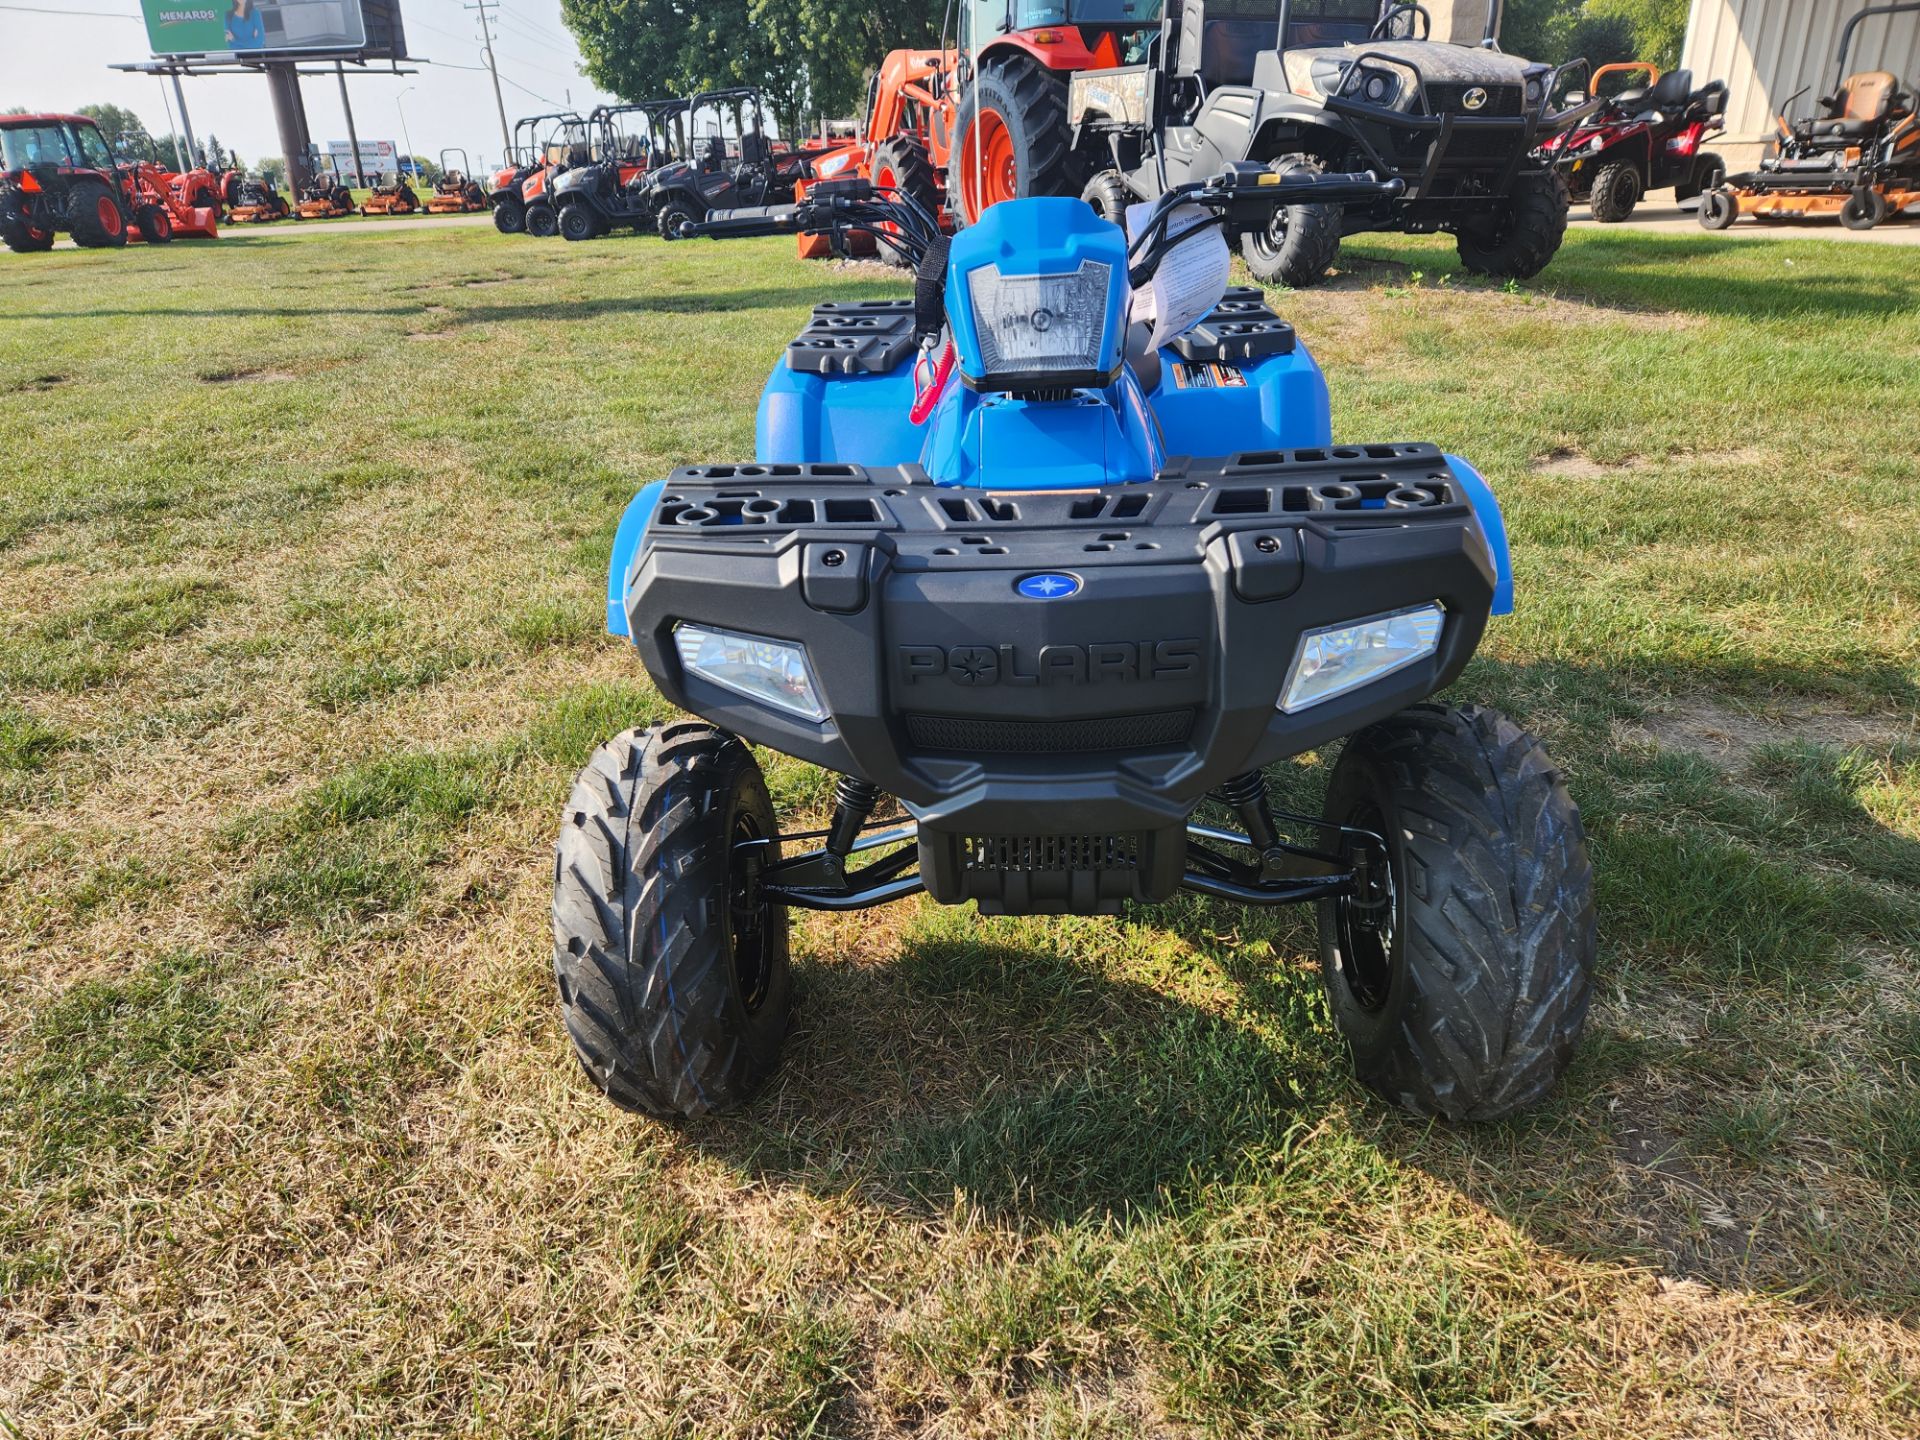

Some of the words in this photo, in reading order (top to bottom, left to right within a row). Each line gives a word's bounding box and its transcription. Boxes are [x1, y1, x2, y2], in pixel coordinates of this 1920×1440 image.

[160, 9, 215, 21] MENARDS
[1185, 212, 1205, 225] System
[898, 638, 1203, 686] POLARIS
